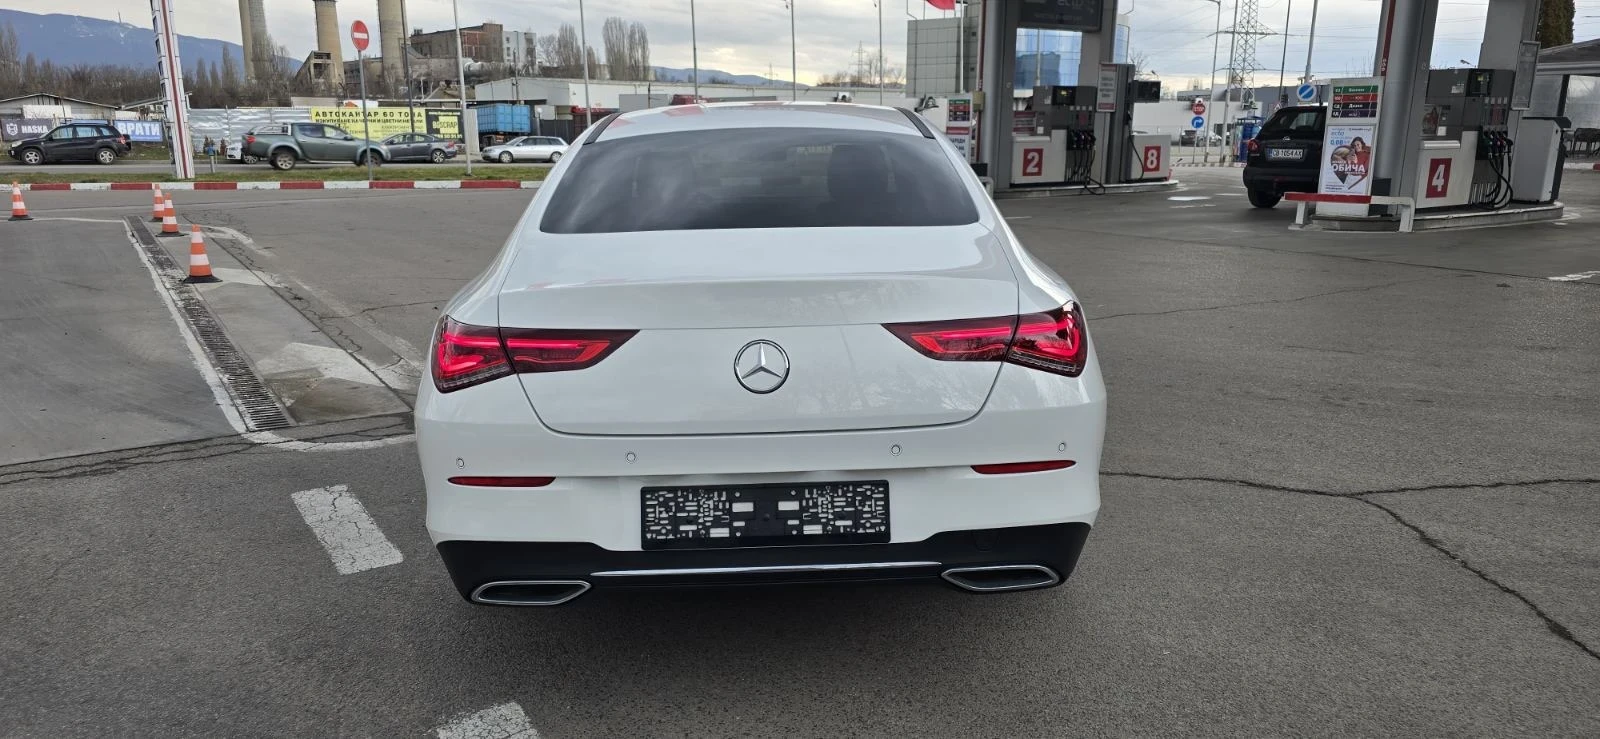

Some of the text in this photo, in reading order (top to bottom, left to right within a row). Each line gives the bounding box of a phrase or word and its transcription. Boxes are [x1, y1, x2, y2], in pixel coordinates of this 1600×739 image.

[21, 125, 48, 134] HASKA
[118, 122, 160, 136] ВРАТИ
[1026, 152, 1039, 173] 2
[1146, 149, 1157, 168] 8
[1332, 164, 1366, 172] ОБИЧА
[1432, 164, 1445, 192] 4
